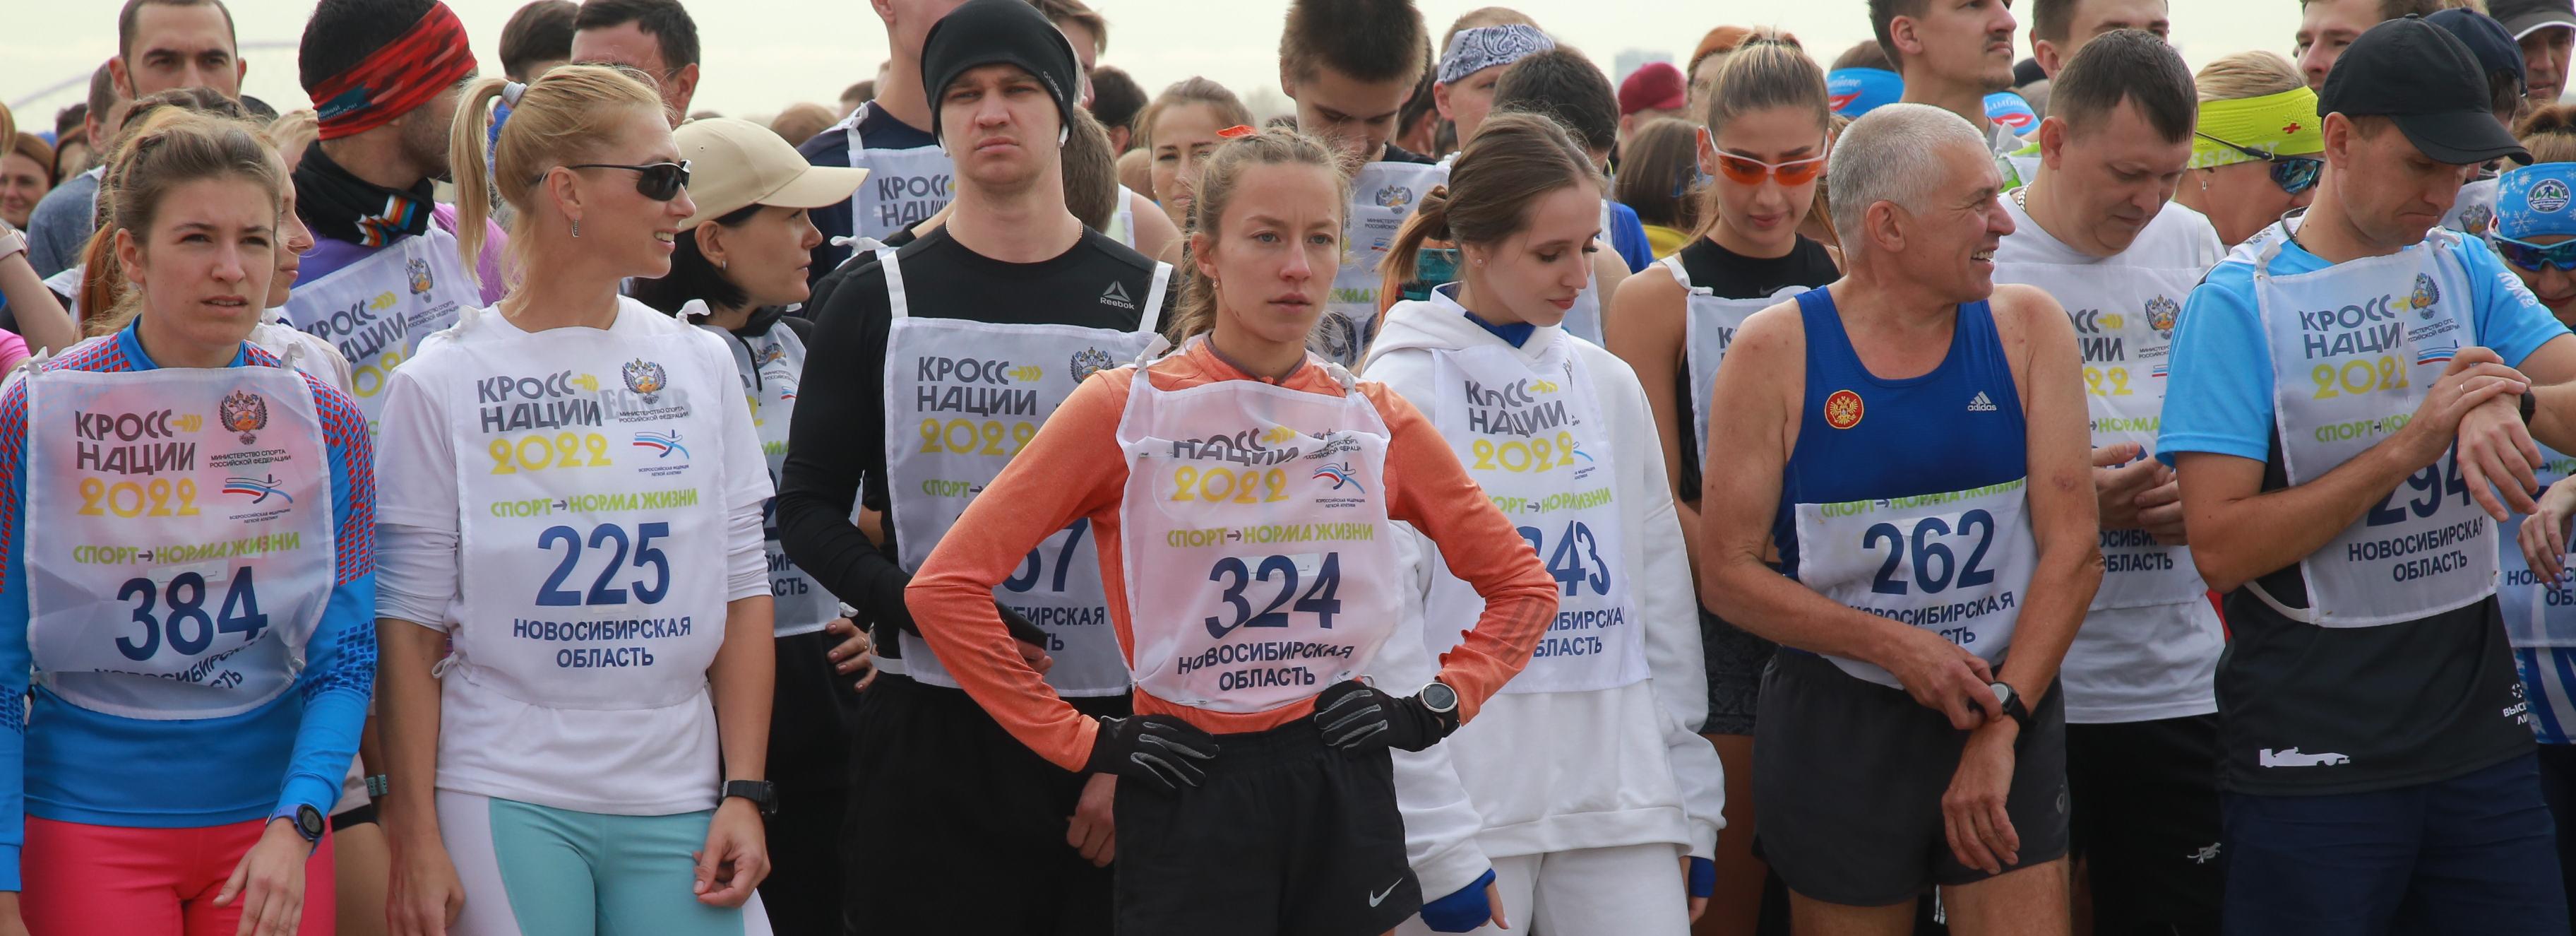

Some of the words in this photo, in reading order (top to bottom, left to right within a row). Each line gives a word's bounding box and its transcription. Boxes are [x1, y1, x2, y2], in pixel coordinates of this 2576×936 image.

[878, 174, 949, 201] КРОСС
[1100, 297, 1135, 310] Reebok
[2298, 294, 2395, 332] КРОСС
[338, 312, 408, 365] АЦИИ
[477, 369, 575, 403] КРОСС
[917, 357, 1009, 384] КРОСС
[480, 398, 602, 433] НАЦИИ
[619, 408, 664, 417] МИНИСТЕРСТВО
[917, 386, 1037, 416] НАЦИИ
[75, 409, 173, 442] КРОСС
[619, 415, 657, 423] РОССИЙСКОЙ
[2315, 420, 2374, 443] СПОРТ
[77, 441, 196, 475] НАЦИИ
[209, 458, 252, 468] РОССИЙСКОЙ
[253, 454, 292, 464] ФЕДЕРАЦИИ
[210, 451, 261, 461] МИНИСТЕРСТВО
[489, 432, 612, 475] 2022
[1472, 430, 1575, 473] 2022
[77, 477, 200, 519] 2022
[922, 480, 970, 498] СПОРТ
[1170, 465, 1289, 504] 2022
[491, 499, 553, 518] СПОРТ
[569, 492, 636, 513] НОРМА
[642, 487, 698, 508] ЖИЗНИ
[73, 545, 139, 564] СПОРТ
[155, 541, 227, 564] НОРМА
[229, 531, 300, 557] ЖИЗНИ
[1167, 527, 1227, 547] СПОРТ
[1243, 524, 1312, 544] НОРМА
[1315, 522, 1374, 542] ЖИЗНИ
[2349, 516, 2483, 562] НОВОСИБИРСКАЯ
[535, 521, 670, 606] 225
[1862, 508, 1996, 596] 262
[2393, 550, 2468, 582] ОБЛАСТЬ
[1205, 552, 1341, 639] 324
[115, 566, 268, 661] 384
[513, 616, 691, 641] НОВОСИБИРСКАЯ
[556, 647, 654, 668] ОБЛАСТЬ
[1178, 641, 1354, 675] НОВОСИБИРСКАЯ
[1533, 636, 1602, 657] БЛАСТЬ
[1219, 666, 1316, 691] ОБЛАСТЬ
